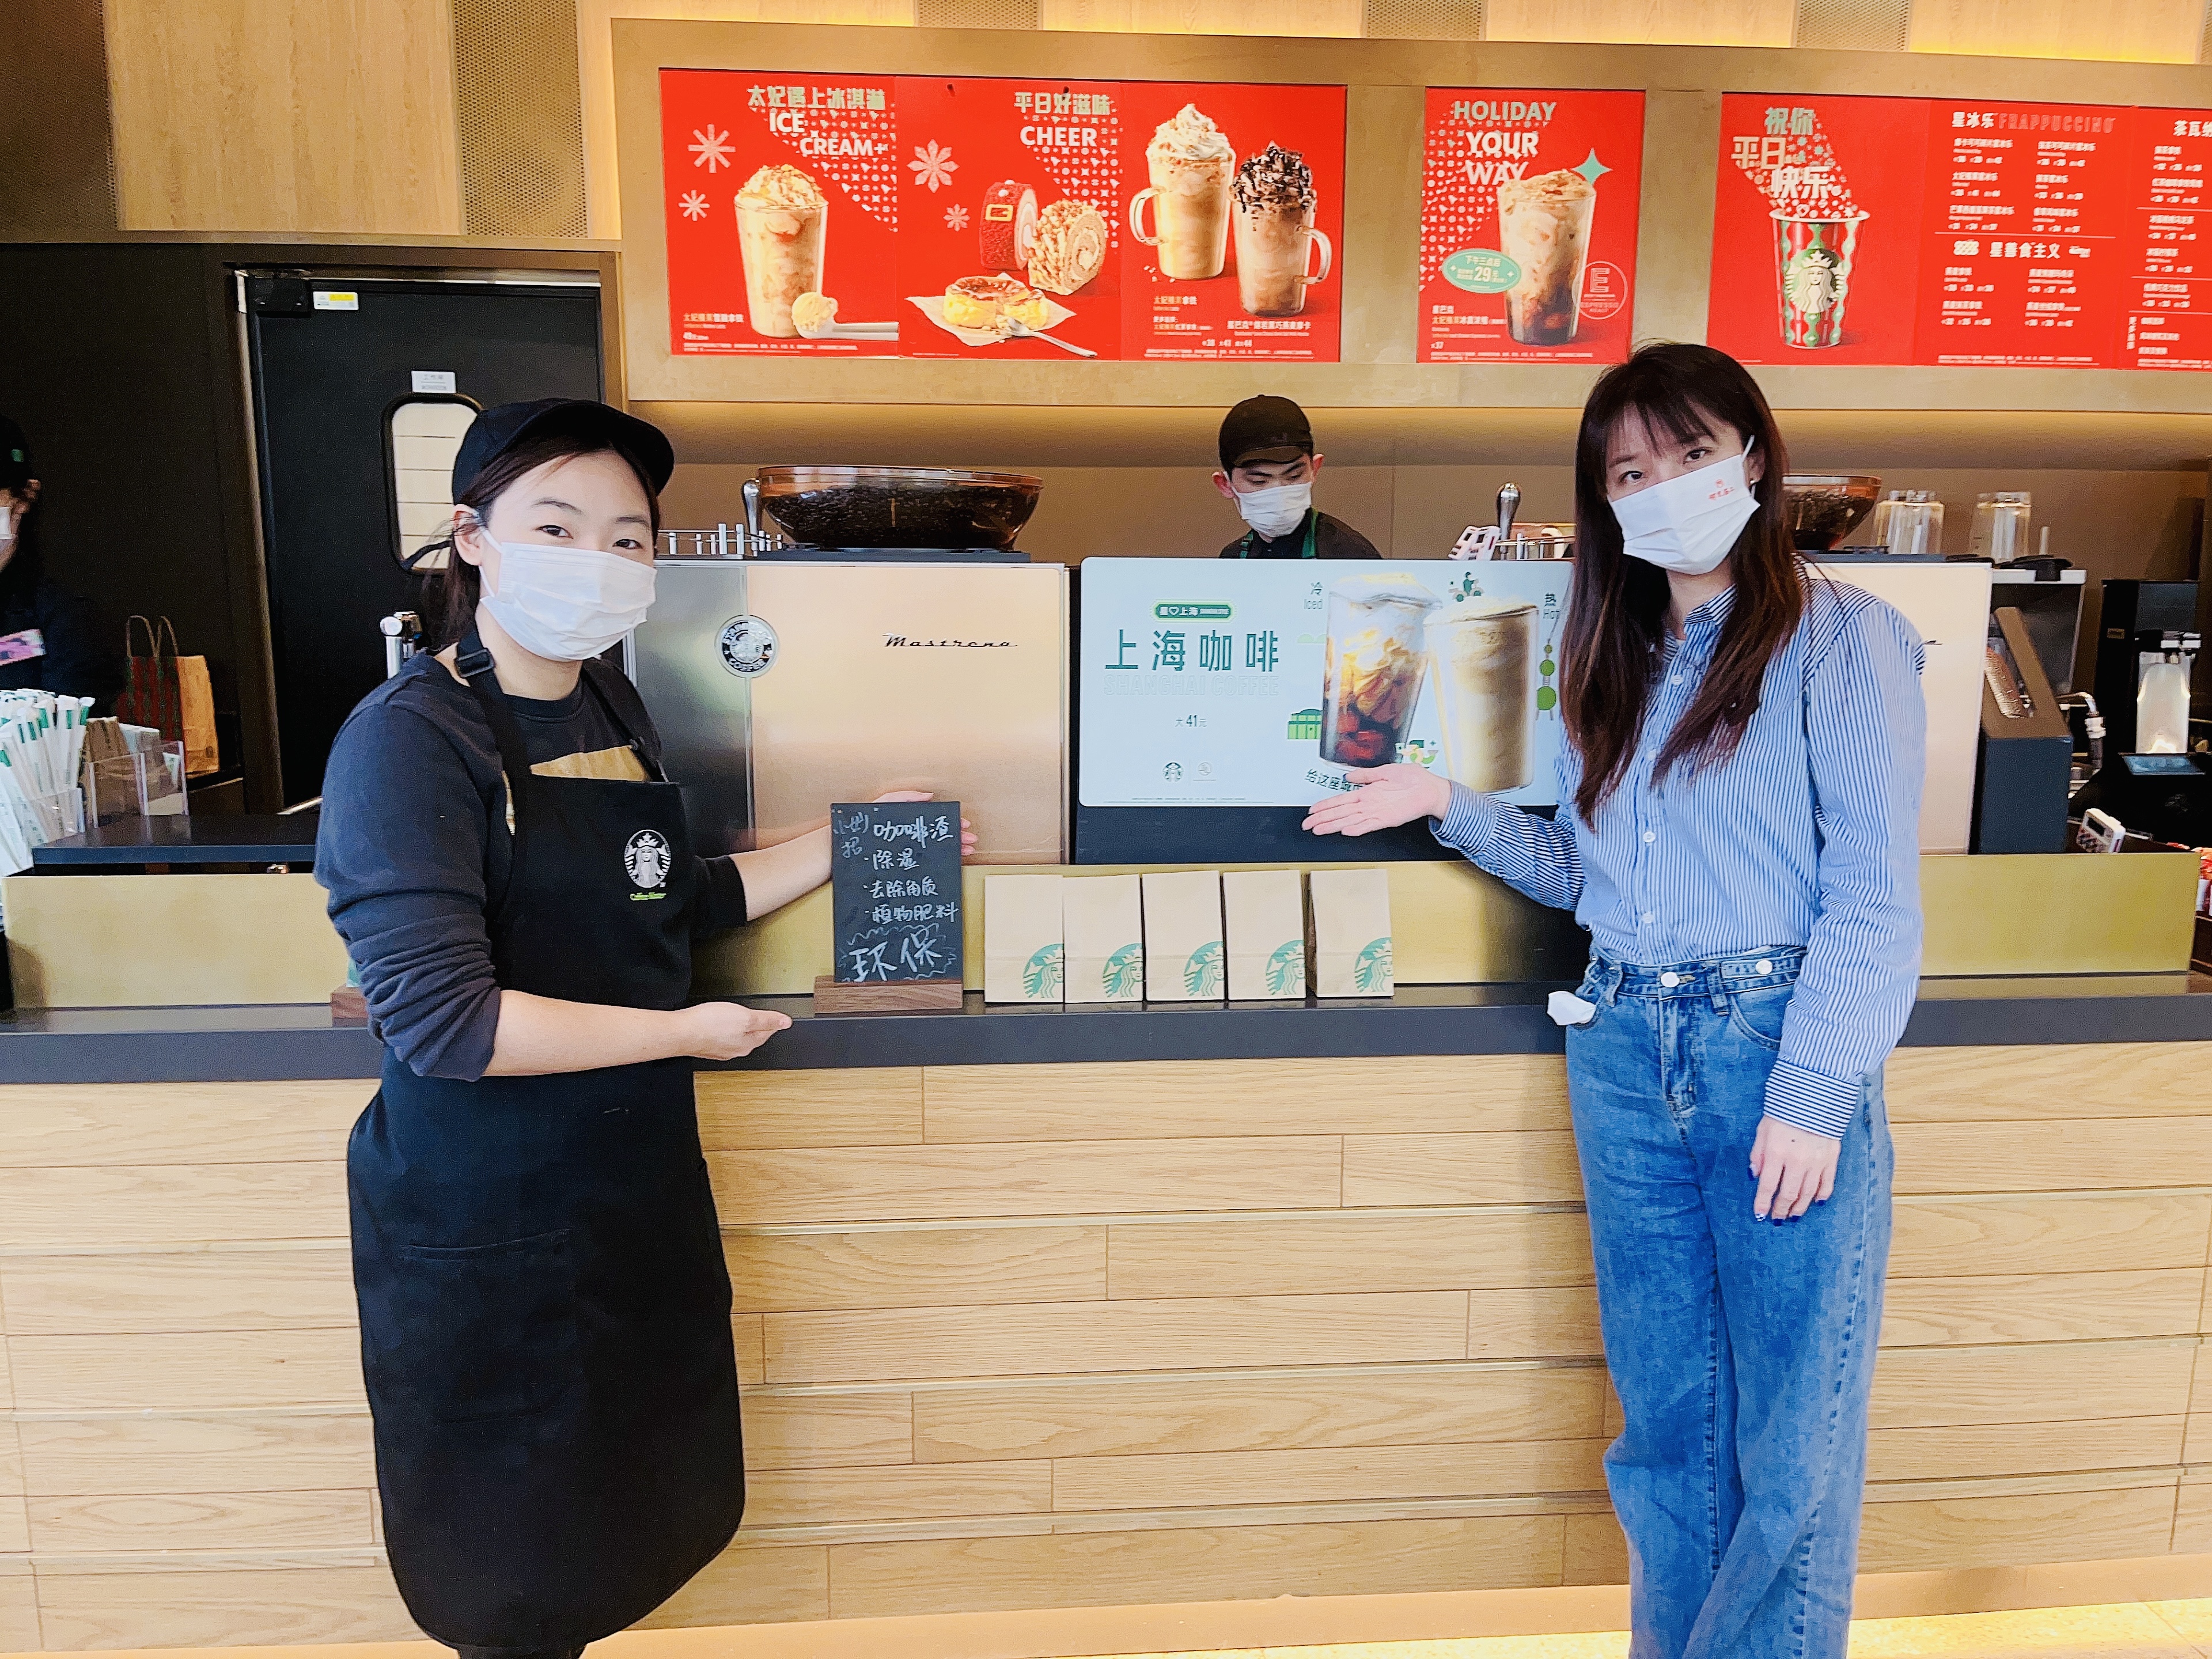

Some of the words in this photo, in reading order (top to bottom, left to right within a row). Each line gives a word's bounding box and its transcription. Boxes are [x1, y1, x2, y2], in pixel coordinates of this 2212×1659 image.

[1014, 92, 1111, 115] 平日好滋味
[1453, 100, 1557, 121] HOLIDAY
[769, 112, 805, 133] ICE
[1764, 107, 1815, 135] 祝你
[1952, 111, 1995, 128] 星冰乐
[1020, 126, 1098, 147] CHEER
[1465, 132, 1539, 154] YOUR
[1731, 136, 1786, 169] 平日
[1465, 161, 1529, 186] WAY
[1771, 165, 1831, 199] 快乐
[1474, 266, 1492, 282] 29
[1310, 582, 1323, 596] 冷
[1105, 629, 1279, 672] 上海咖啡
[1103, 674, 1206, 696] SHANGHAI
[1211, 675, 1279, 696] COFFEE
[873, 815, 954, 849] 咖啡渣
[848, 928, 942, 982] 环保
